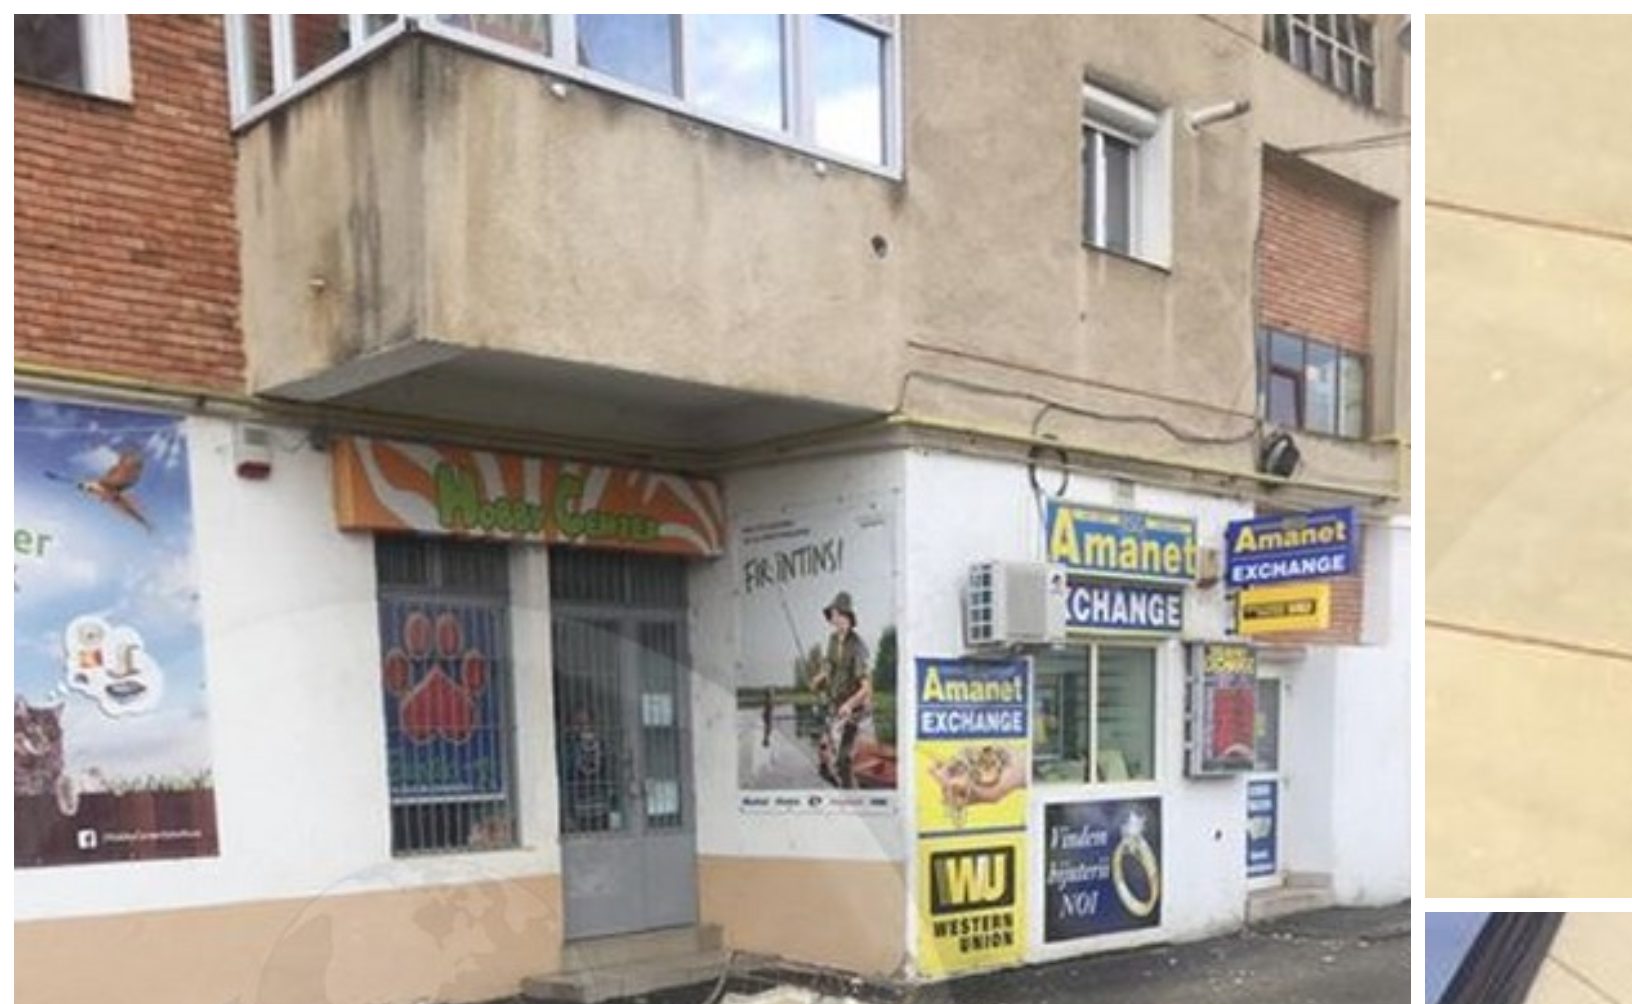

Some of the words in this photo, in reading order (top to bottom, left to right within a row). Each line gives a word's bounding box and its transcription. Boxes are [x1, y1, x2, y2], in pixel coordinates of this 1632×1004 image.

[1050, 505, 1197, 574] Amanet
[1234, 520, 1347, 554] Amanet
[1232, 553, 1346, 582] EXCHANGE
[923, 664, 1023, 702] Amanet
[921, 710, 1023, 735] EXCHANGE
[1049, 824, 1108, 850] Vindem
[933, 852, 1007, 905] WU
[934, 912, 1014, 938] WESTERN
[960, 930, 1014, 953] UNION
